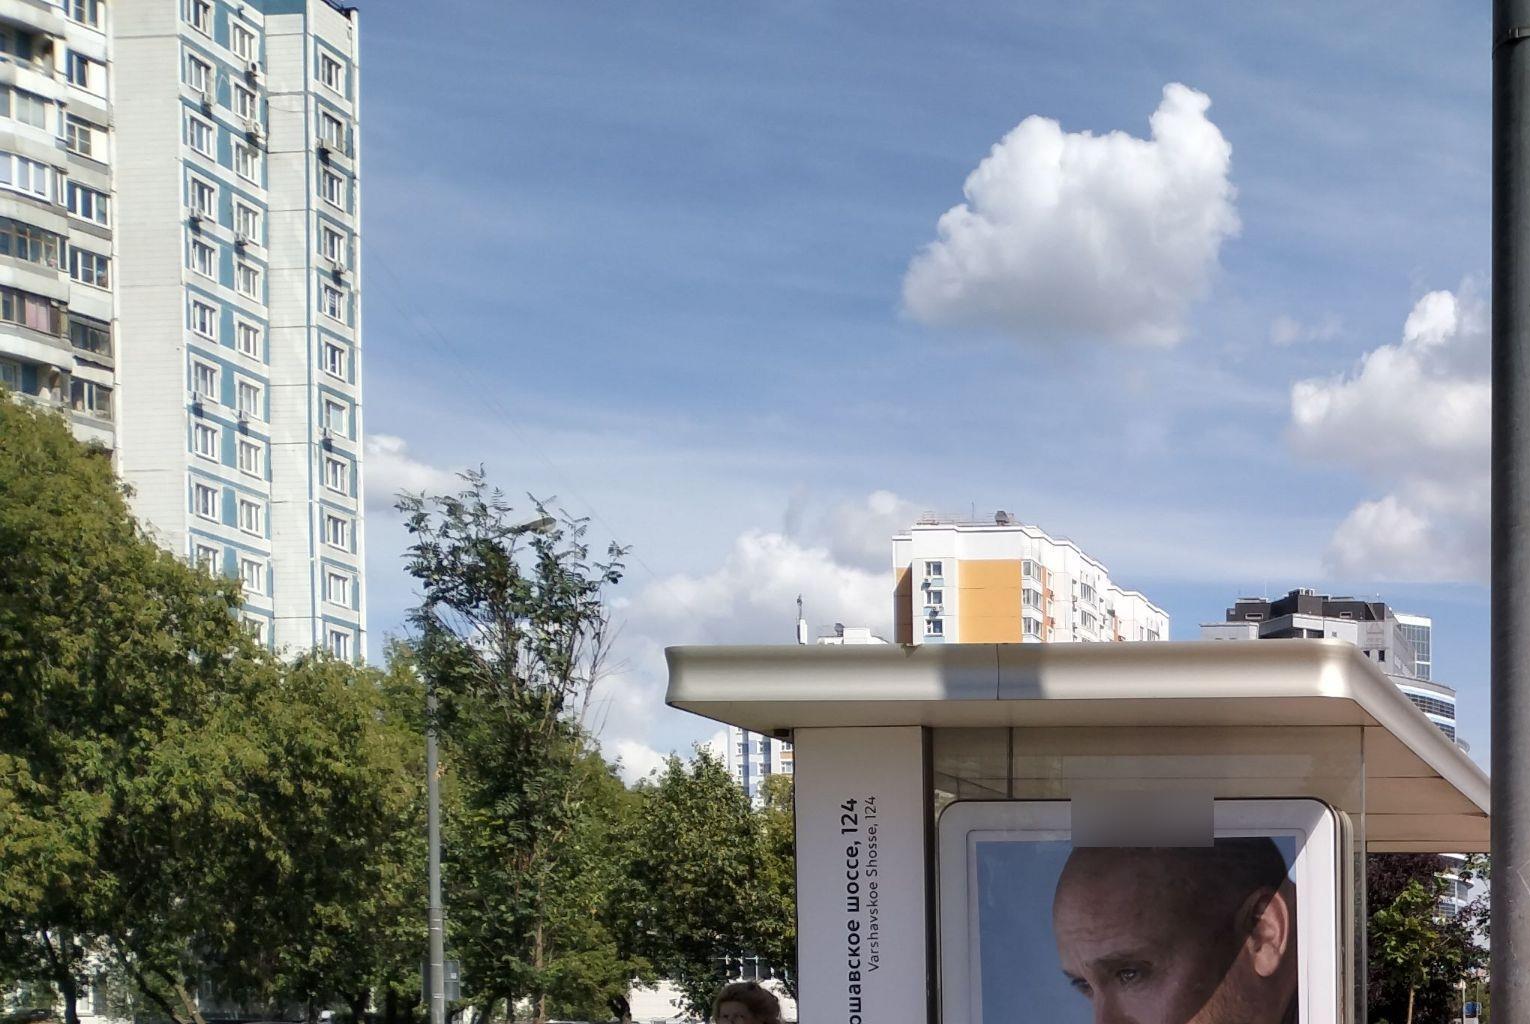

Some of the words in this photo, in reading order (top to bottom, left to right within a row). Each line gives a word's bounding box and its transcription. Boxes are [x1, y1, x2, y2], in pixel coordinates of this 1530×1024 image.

[841, 798, 858, 835] 124
[864, 796, 877, 819] 124
[846, 841, 862, 912] шоссе,
[866, 824, 879, 877] Shosse,
[866, 882, 881, 972] Varshavskoe
